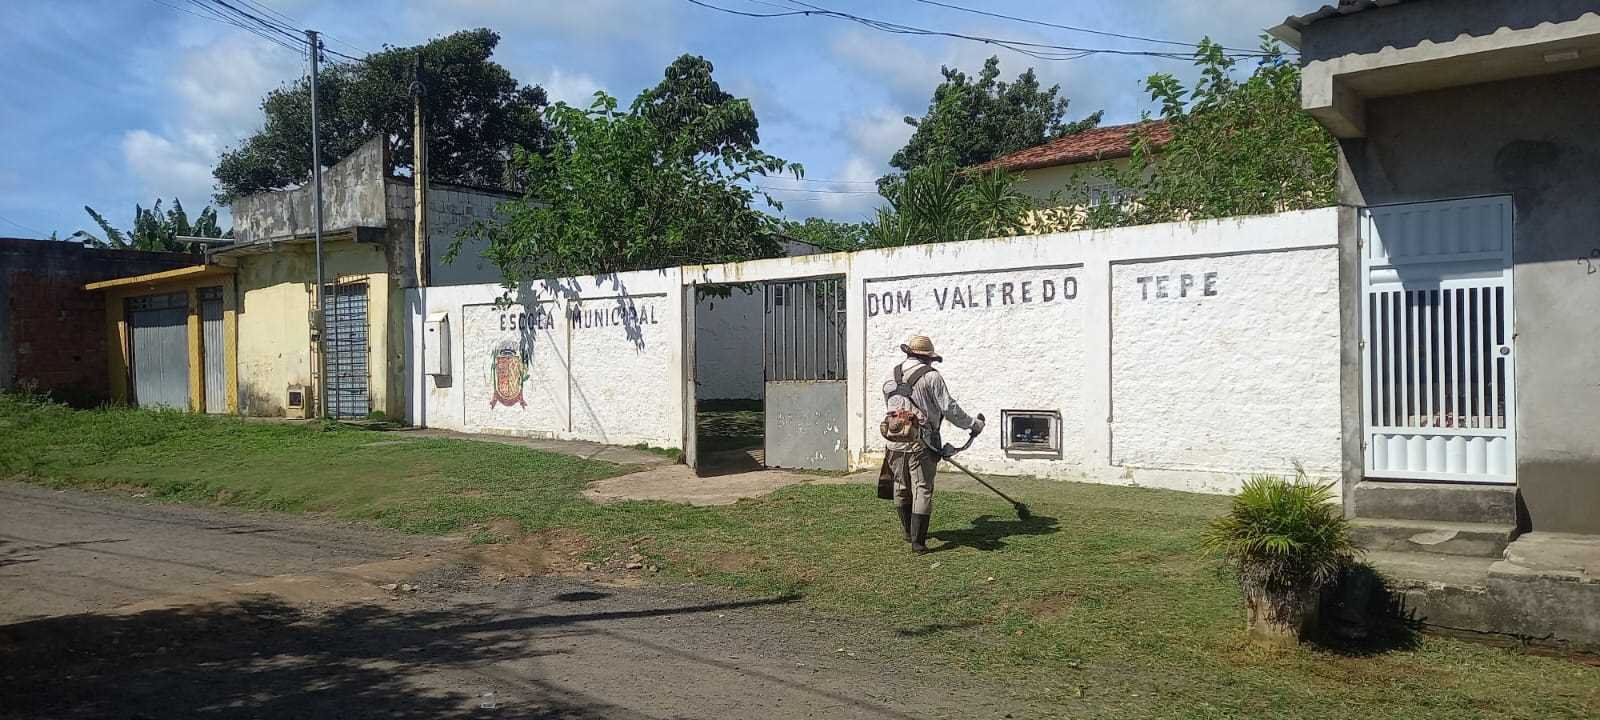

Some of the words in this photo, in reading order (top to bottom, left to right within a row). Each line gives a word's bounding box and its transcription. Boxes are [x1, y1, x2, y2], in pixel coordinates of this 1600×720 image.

[499, 311, 555, 331] ESCOLA
[572, 304, 658, 330] MUNICIPAL
[867, 290, 913, 317] DOM
[934, 276, 1079, 311] VALFREDO
[1136, 271, 1219, 300] TEPE
